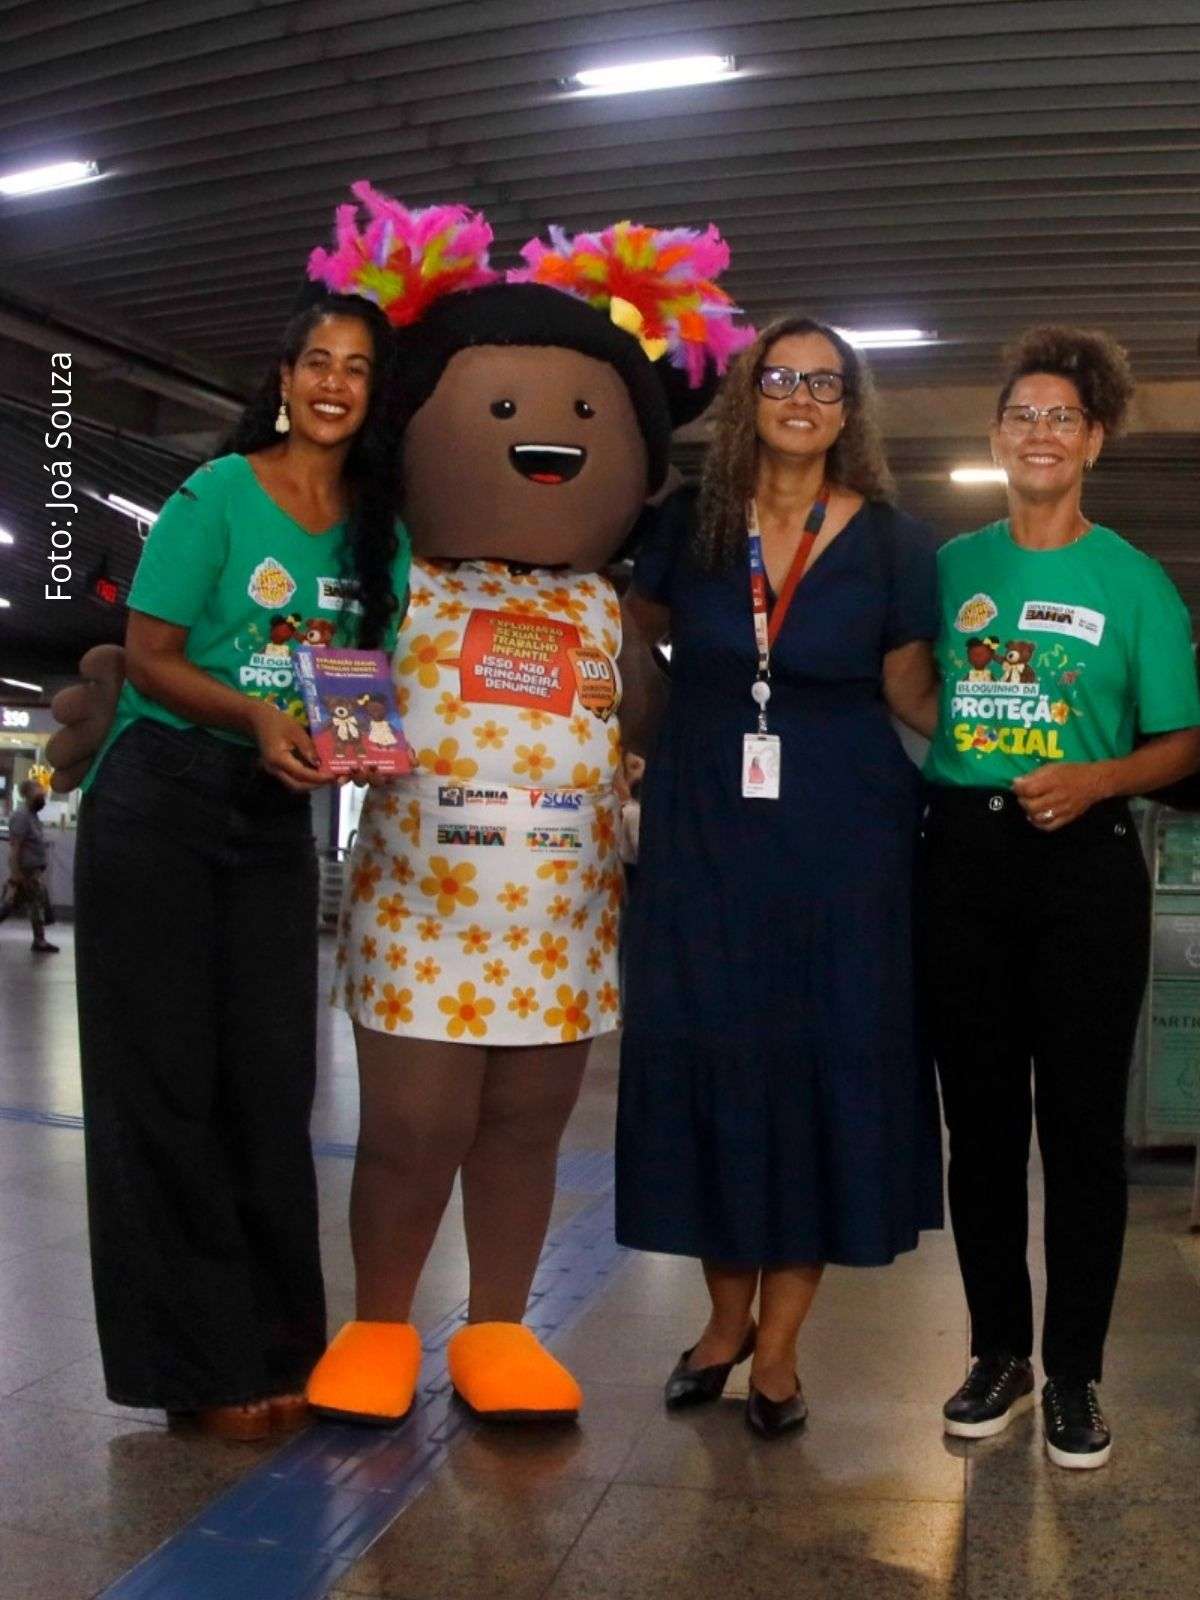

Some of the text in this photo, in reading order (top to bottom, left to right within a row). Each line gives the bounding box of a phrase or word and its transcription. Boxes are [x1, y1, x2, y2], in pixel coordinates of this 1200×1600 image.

[1025, 609, 1073, 625] BAHIA
[496, 628, 557, 642] SEXUAL E
[482, 655, 513, 670] ISSO
[576, 660, 610, 679] 100
[958, 684, 1037, 695] BLOQUINHO DA
[954, 723, 1064, 759] SOCIAL
[466, 790, 509, 799] BAHIA
[543, 792, 584, 806] SUAS
[437, 829, 505, 846] BAHIA
